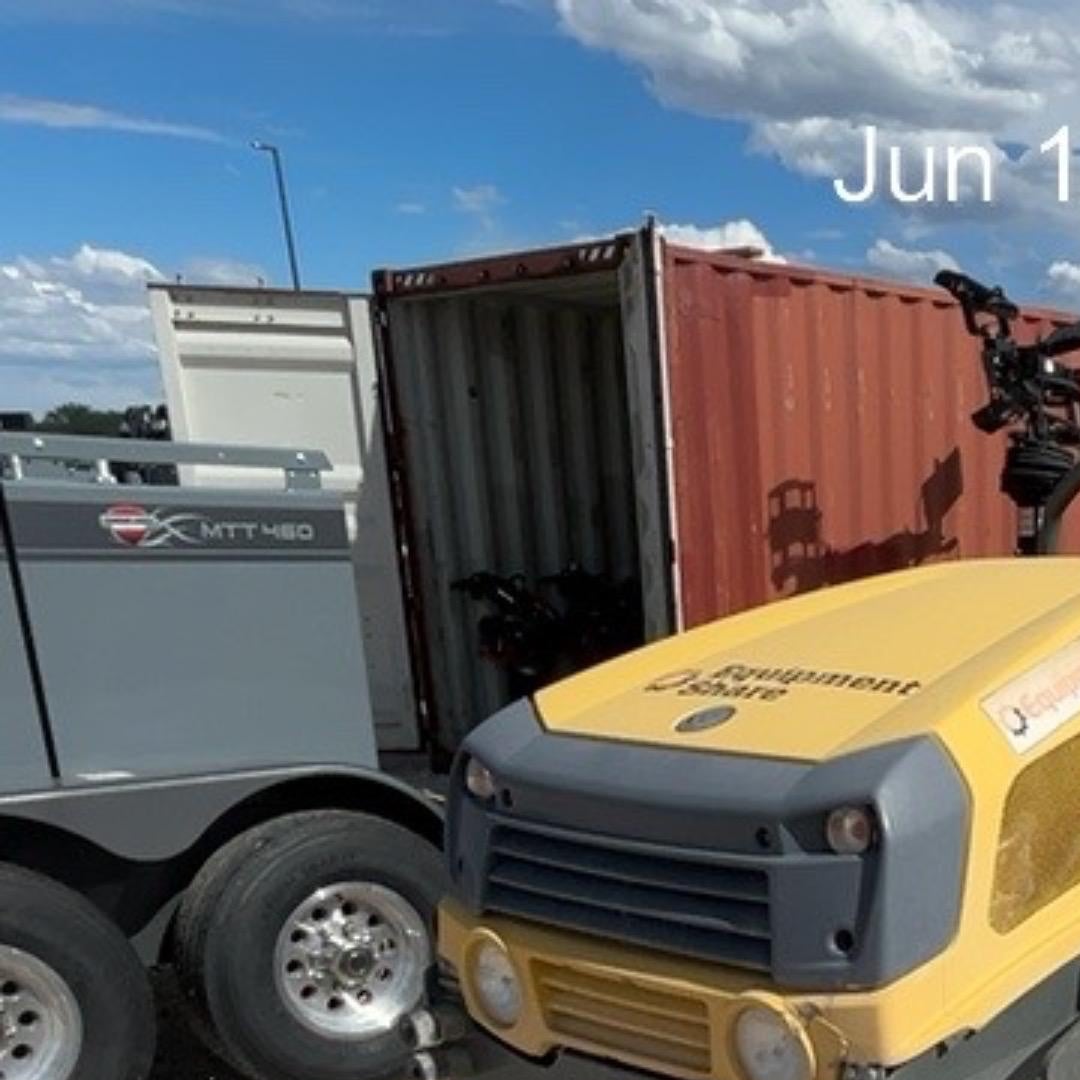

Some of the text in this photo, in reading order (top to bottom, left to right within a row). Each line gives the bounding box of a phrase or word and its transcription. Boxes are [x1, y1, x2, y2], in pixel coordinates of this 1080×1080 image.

[201, 521, 258, 540] MTT
[712, 664, 921, 695] Equipment
[677, 681, 789, 701] Share
